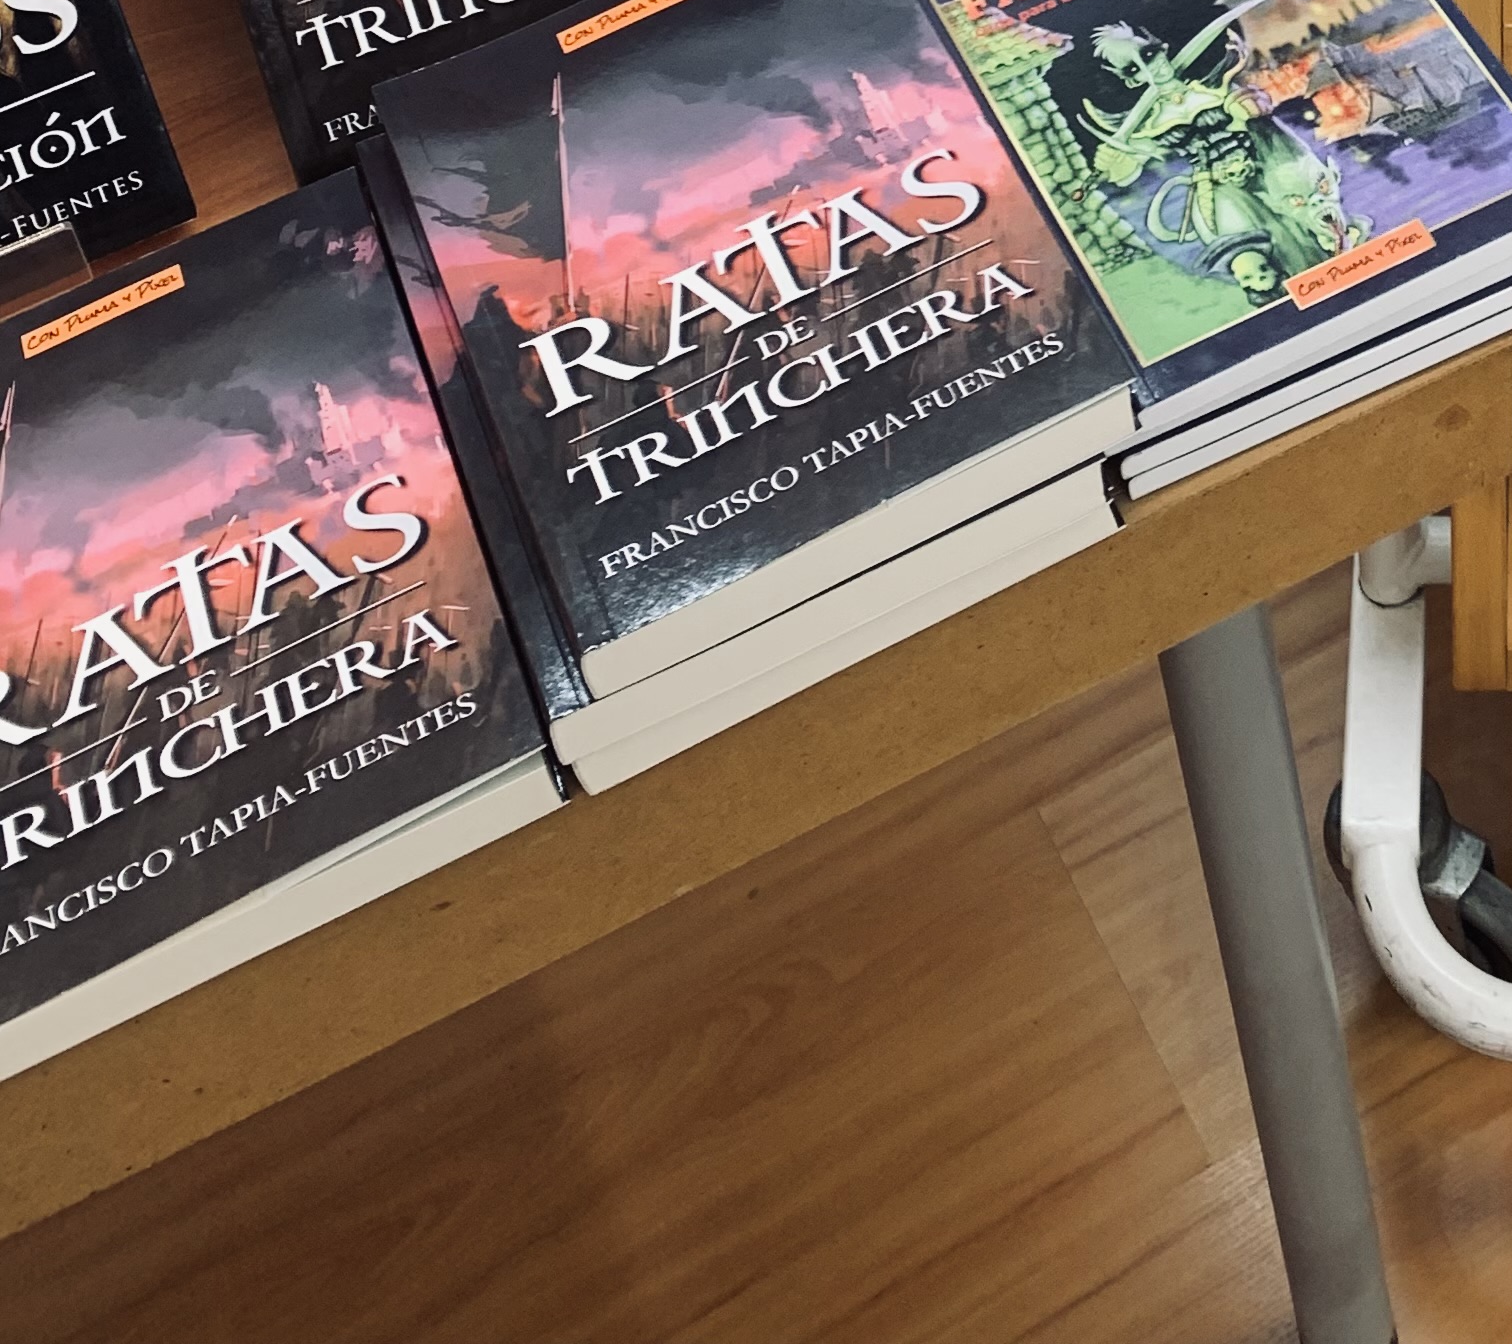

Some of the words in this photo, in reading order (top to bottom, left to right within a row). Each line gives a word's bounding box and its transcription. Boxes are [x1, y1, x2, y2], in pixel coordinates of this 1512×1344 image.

[563, 26, 595, 46] CON
[1018, 0, 1058, 23] para
[0, 168, 145, 248] -FUENTES
[518, 146, 985, 419] RATAS
[27, 327, 60, 350] CON
[754, 315, 814, 360] DE
[566, 264, 1034, 508] TRINCHERA
[597, 463, 800, 580] FRANCISCO
[802, 332, 1065, 476] TAPIA-FUENTES
[156, 670, 223, 724] DE
[0, 608, 459, 872] RINCHERA
[0, 846, 174, 955] ANCISCO
[180, 690, 479, 858] TAPIA-FUENTES
